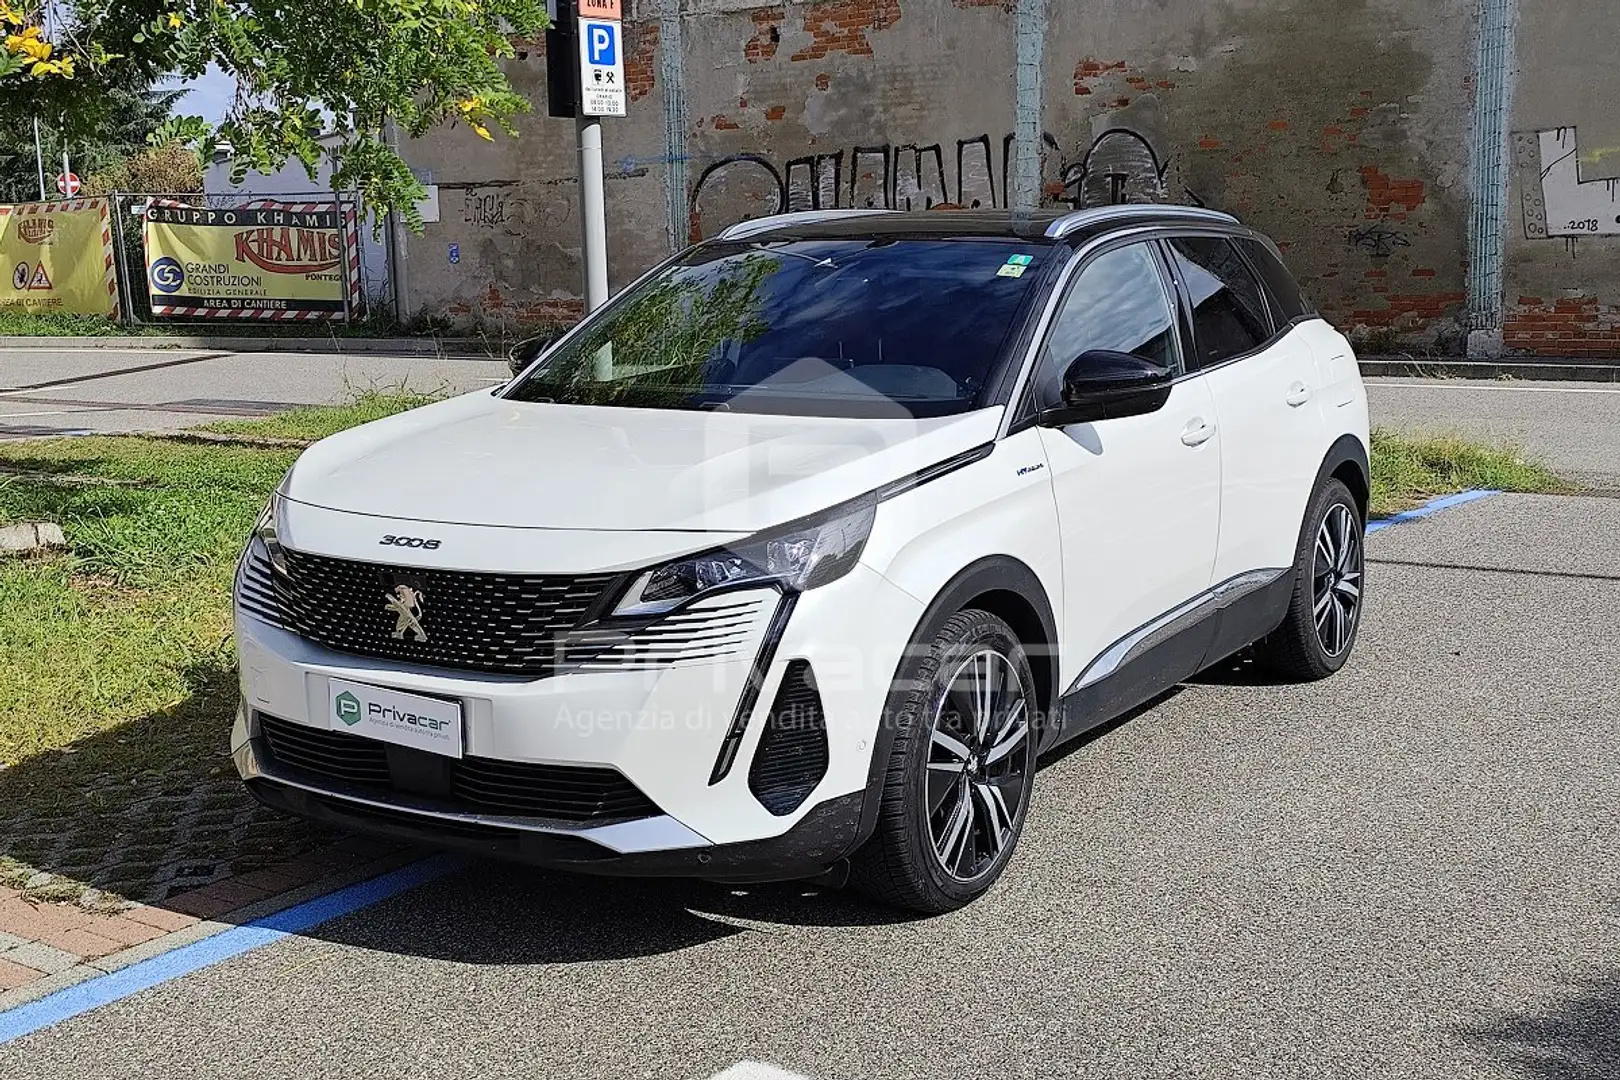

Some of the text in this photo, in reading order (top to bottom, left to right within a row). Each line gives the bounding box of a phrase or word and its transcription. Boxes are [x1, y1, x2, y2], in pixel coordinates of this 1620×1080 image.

[593, 28, 610, 61] P
[147, 208, 237, 225] GRUPPO
[234, 227, 341, 270] KHAMIS
[185, 262, 230, 275] GRANDI
[187, 274, 262, 288] COSTRUZIONI
[188, 288, 268, 298] EDILIZIA GENERALE
[203, 299, 287, 309] AREA DI CANTIERE
[379, 534, 442, 550] 3008
[367, 702, 452, 732] Privacar
